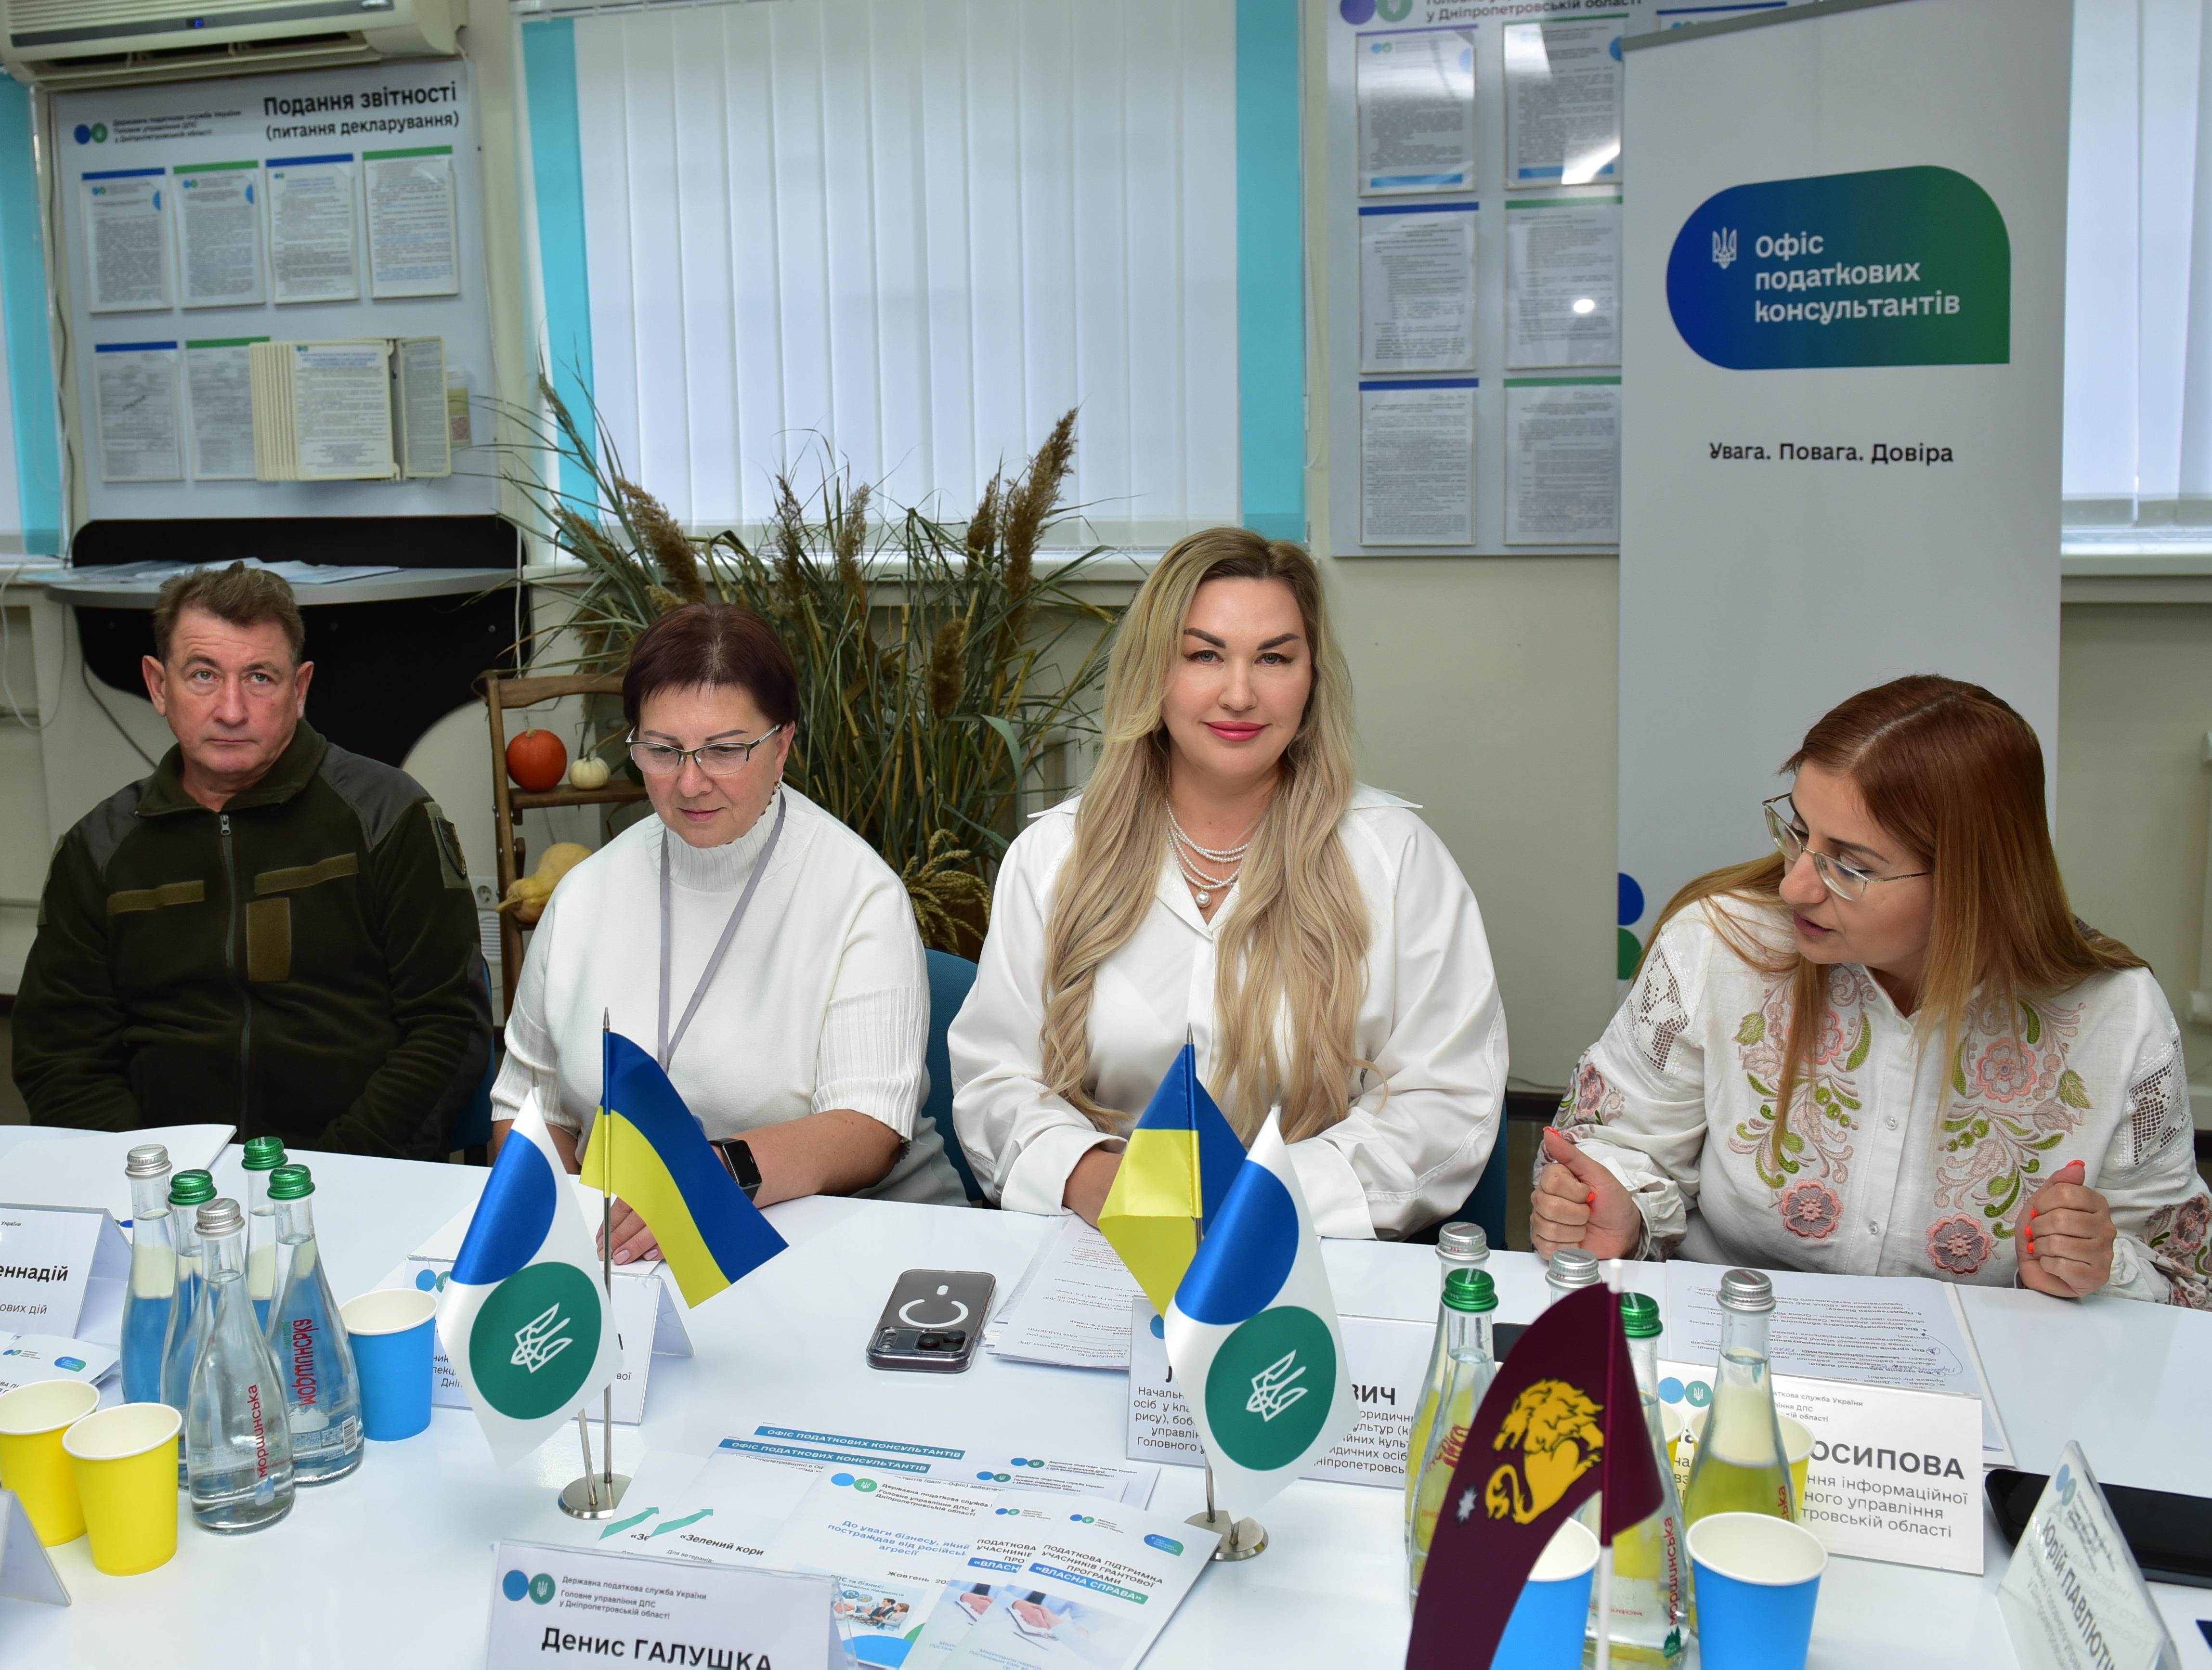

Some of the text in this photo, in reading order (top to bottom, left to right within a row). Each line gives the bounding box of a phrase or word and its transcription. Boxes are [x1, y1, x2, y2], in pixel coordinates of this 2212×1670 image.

[1439, 2, 1581, 20] Дніпропетровській
[263, 81, 456, 117] Подання звітності
[266, 111, 459, 142] (питання декларування)
[1755, 232, 1824, 261] Офіс
[1755, 262, 1921, 292] податкових
[1755, 290, 1960, 324] консультантів
[1709, 442, 1954, 466] Увага. Повага. Довіра
[28, 1305, 47, 1315] дій
[1133, 1399, 1169, 1412] осіб у
[1801, 1395, 1863, 1407] служба України
[1135, 1413, 1169, 1424] рису),
[247, 1383, 269, 1479] моршинська
[796, 1433, 869, 1447] ПОДАТКОВИХ
[871, 1442, 961, 1458] КОНСУЛЬТАНТІВ
[1138, 1437, 1197, 1451] Головного
[1383, 1451, 1407, 1461] осіб
[731, 1442, 759, 1450] ОФІС
[760, 1445, 834, 1460] ПОДАТКОВИХ
[836, 1455, 927, 1472] КОНСУЛЬТАНТІВ
[1810, 1440, 1965, 1480] ОСИПОВА
[878, 1489, 909, 1499] Головне
[910, 1496, 951, 1507] управління
[882, 1483, 988, 1507] Державна податкова служба
[1842, 1476, 1968, 1505] інформаційної
[875, 1493, 976, 1517] Дніпропетровській області
[1848, 1497, 1943, 1520] управління
[828, 1524, 915, 1549] постраждав від
[842, 1520, 970, 1550] До уваги бізнесу, який
[1888, 1519, 1952, 1539] області
[680, 1534, 765, 1556] «Зелений кори
[879, 1544, 919, 1556] агресії
[976, 1539, 1036, 1551] ПОДАТКОВА
[2042, 1517, 2068, 1578] Юрій
[1041, 1551, 1156, 1588] УЧАСНИКІВ ГРАНТОВОЇ
[1043, 1544, 1163, 1585] ПОДАТКОВА ПІДТРИМКА
[1067, 1565, 1122, 1585] ПРОГРАМИ
[1663, 1516, 1680, 1627] моршинська
[562, 1576, 707, 1601] Державна податкова служба України
[858, 1580, 884, 1589] бізнес:
[887, 1571, 930, 1583] Жовтень
[1035, 1565, 1143, 1602] «ВЛАСНА СПРАВА»
[560, 1590, 656, 1609] Головне управління ДПС
[565, 1600, 639, 1616] Дніпропетровській
[640, 1610, 670, 1620] області
[541, 1626, 772, 1670] Денис ГАЛУШКА
